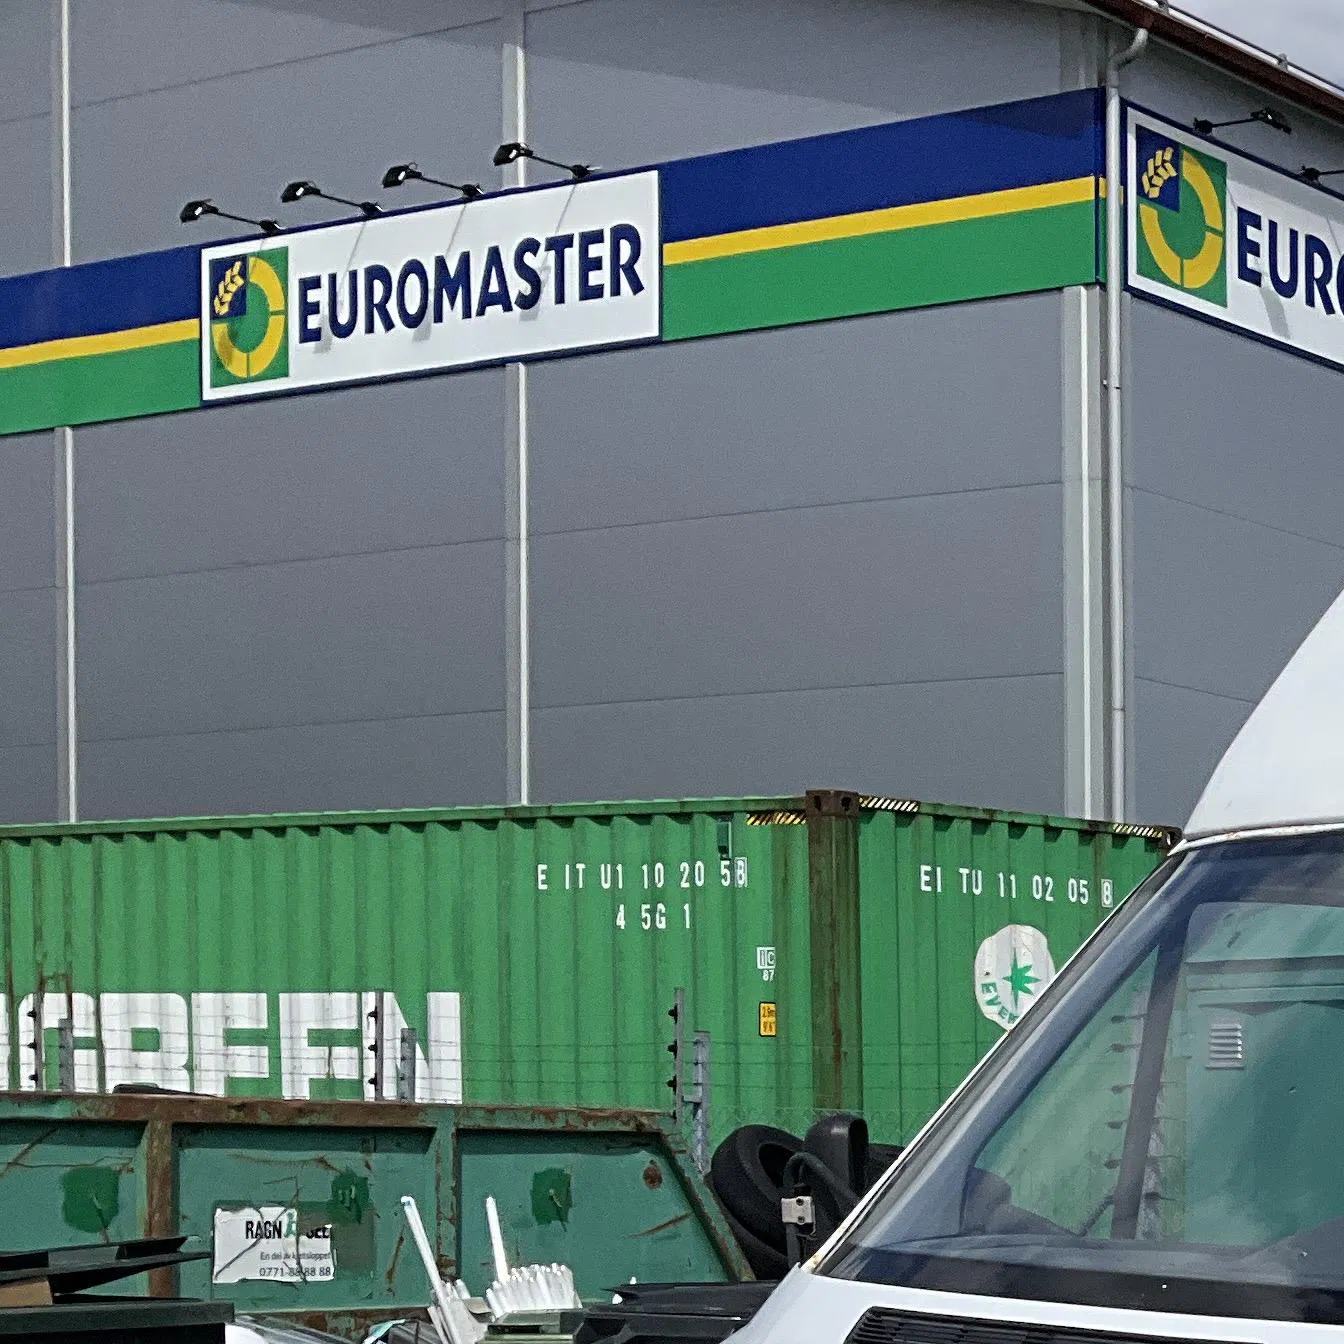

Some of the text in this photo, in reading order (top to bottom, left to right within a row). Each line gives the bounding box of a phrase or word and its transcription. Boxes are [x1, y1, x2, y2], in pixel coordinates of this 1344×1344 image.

[298, 223, 645, 345] EUROMASTER
[0, 992, 463, 1104] GREEN
[246, 1220, 282, 1239] RAGN
[318, 1266, 331, 1277] 88
